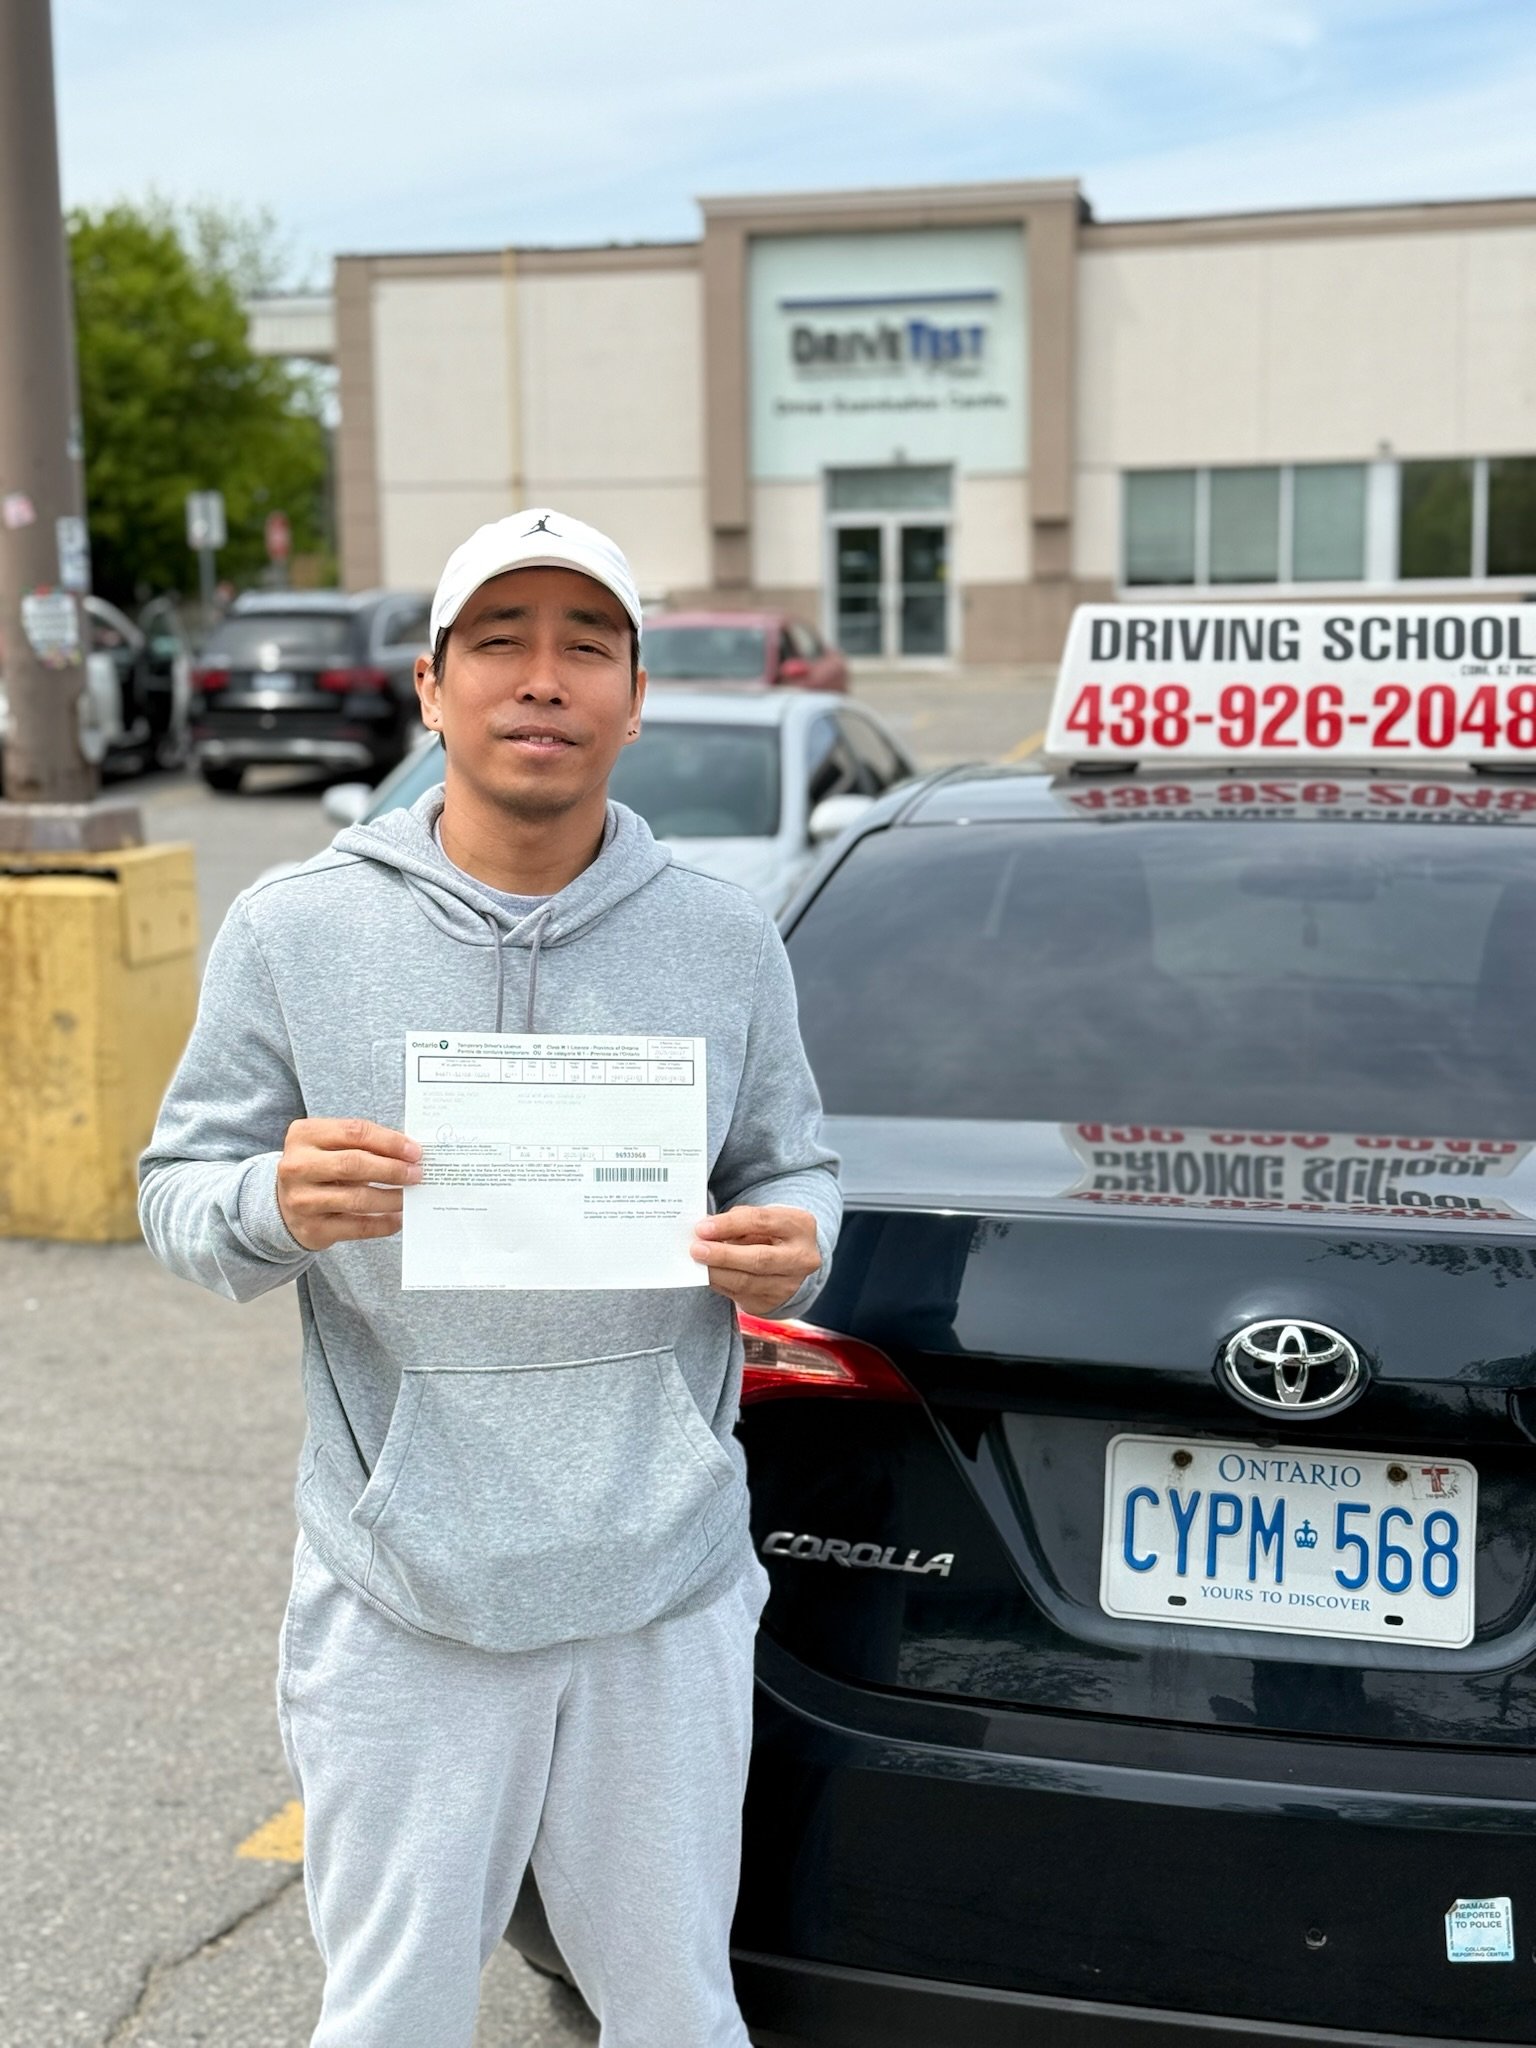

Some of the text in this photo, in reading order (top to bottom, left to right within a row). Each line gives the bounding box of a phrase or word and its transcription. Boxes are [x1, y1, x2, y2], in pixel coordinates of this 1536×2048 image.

[1091, 617, 1536, 662] DRIVING SCHOOL
[1065, 683, 1536, 749] 438-926-2048
[412, 1041, 438, 1049] Ontario
[1218, 1454, 1362, 1491] ONTARIO
[761, 1531, 955, 1577] COROLLA
[1123, 1486, 1460, 1598] CYPM 568
[1200, 1585, 1371, 1612] YOURS TO DISCOVER
[1455, 1911, 1502, 1919] REPORTED
[1460, 1902, 1496, 1910] DAMAGE
